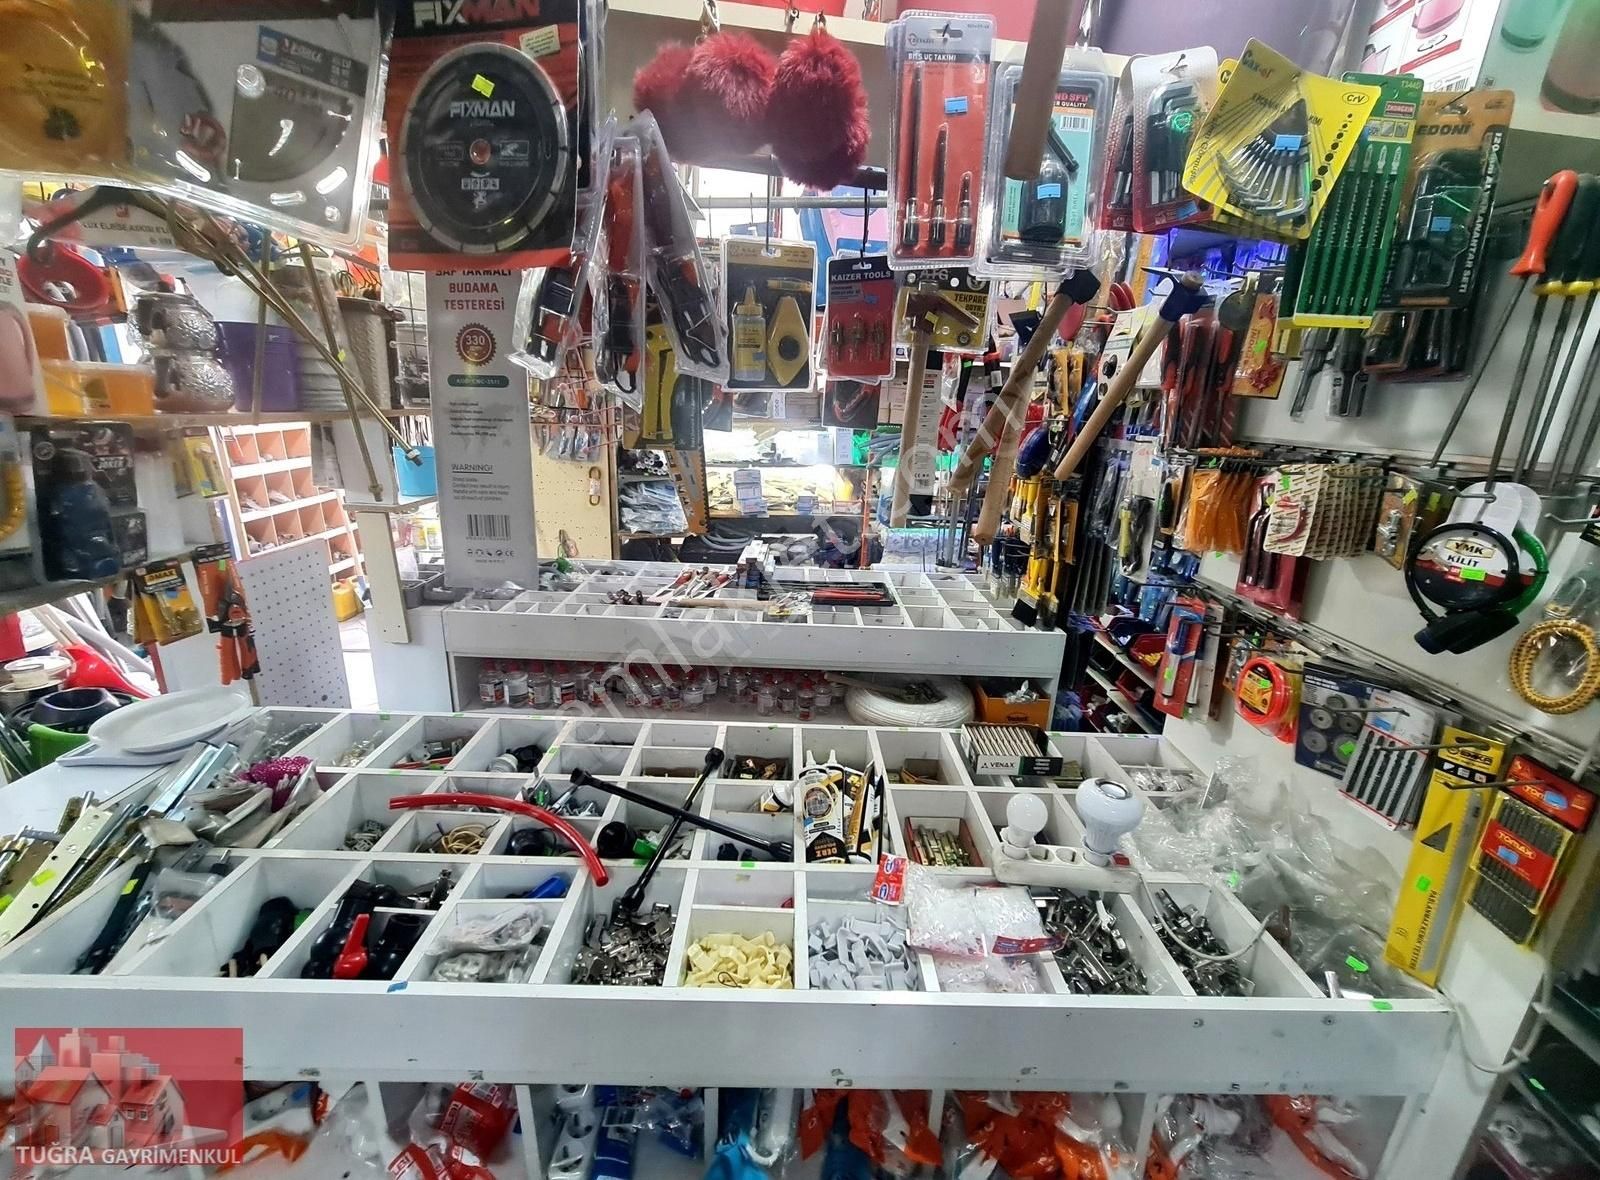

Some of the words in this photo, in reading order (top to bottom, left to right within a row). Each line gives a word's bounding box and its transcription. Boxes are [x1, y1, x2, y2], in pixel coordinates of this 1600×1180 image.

[1346, 93, 1366, 103] CrV
[449, 99, 516, 119] FIXMAN
[1491, 132, 1502, 153] 120
[831, 272, 862, 281] KAIZER
[863, 270, 891, 279] TOOLS
[449, 283, 498, 294] BUDAMA
[444, 297, 505, 311] TESTERESİ
[954, 293, 988, 305] TEKPARE
[465, 335, 485, 345] 330
[452, 463, 493, 472] WARNING!
[1454, 541, 1485, 556] YMK
[1497, 830, 1535, 860] TOMAX
